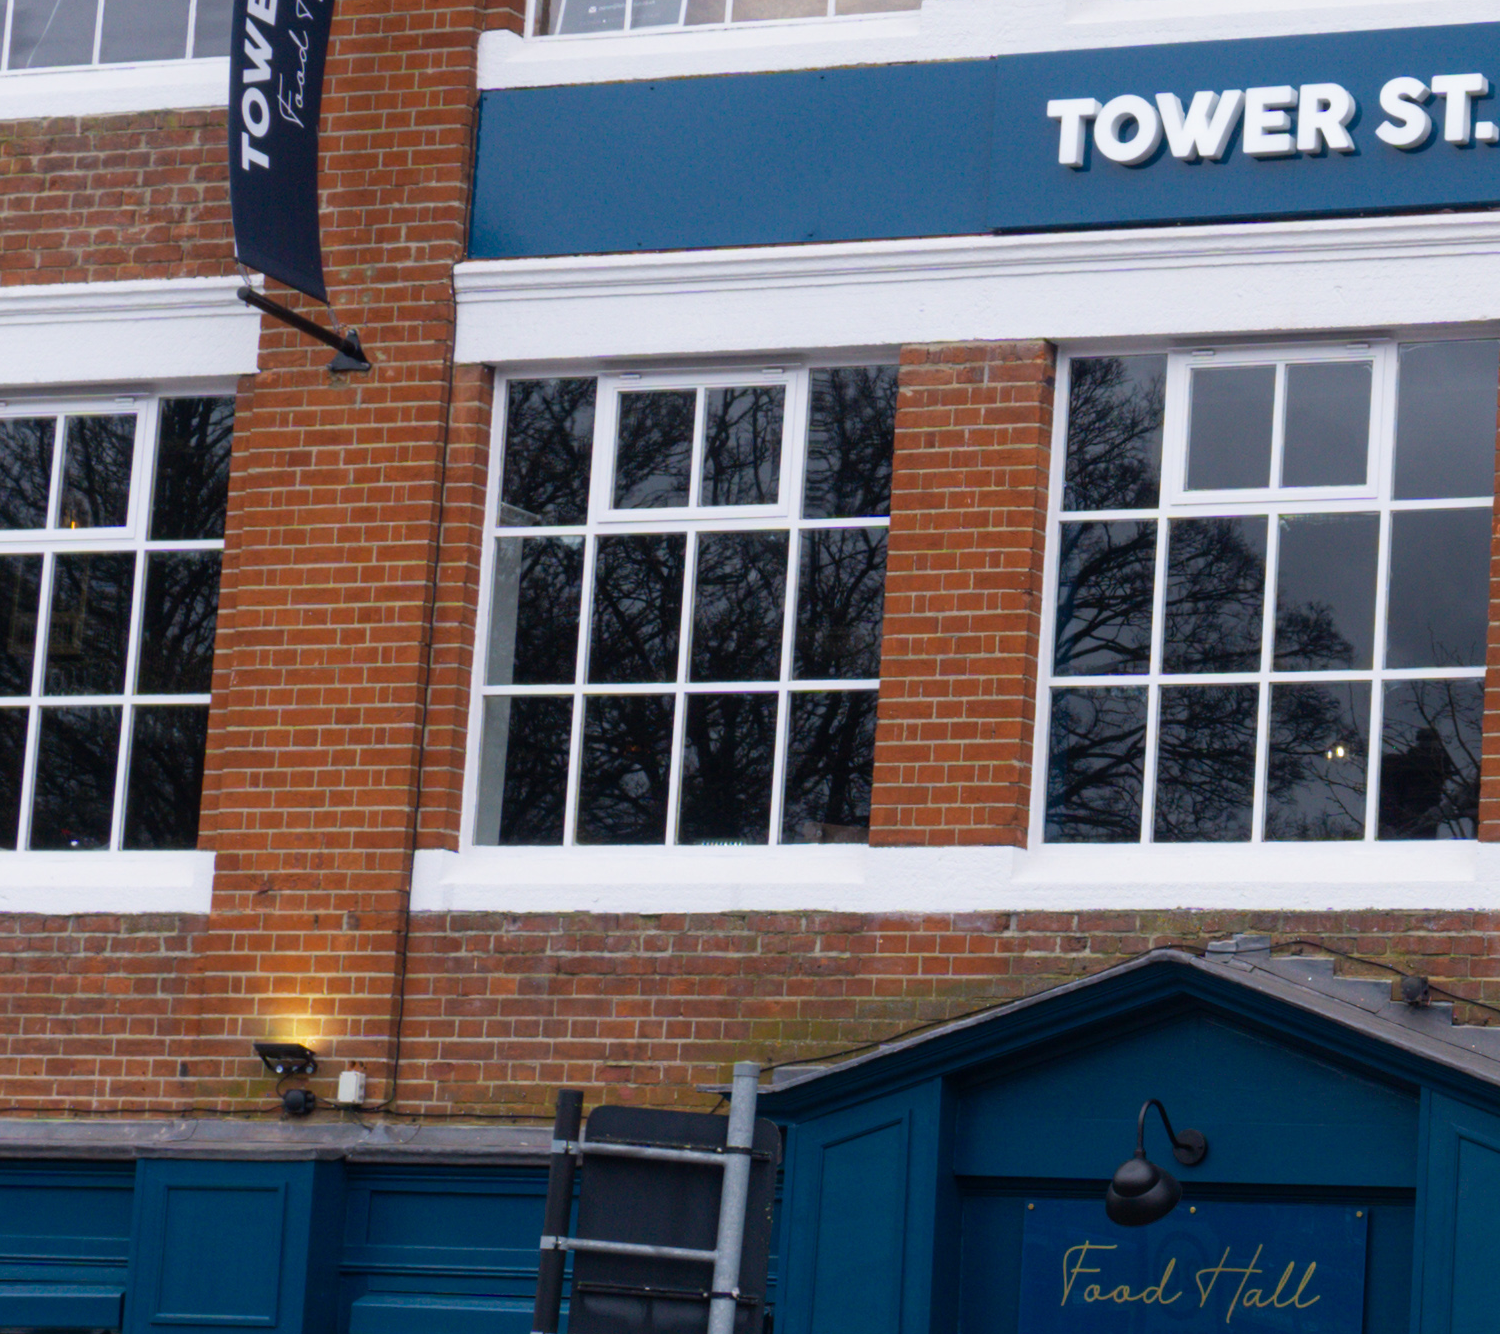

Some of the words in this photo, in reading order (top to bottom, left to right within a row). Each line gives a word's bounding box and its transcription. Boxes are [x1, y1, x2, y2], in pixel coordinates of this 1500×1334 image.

[277, 30, 309, 128] Food
[1047, 82, 1357, 167] TOWER
[1375, 73, 1500, 150] ST.
[1060, 1240, 1182, 1306] Food
[1196, 1244, 1320, 1323] Hall
